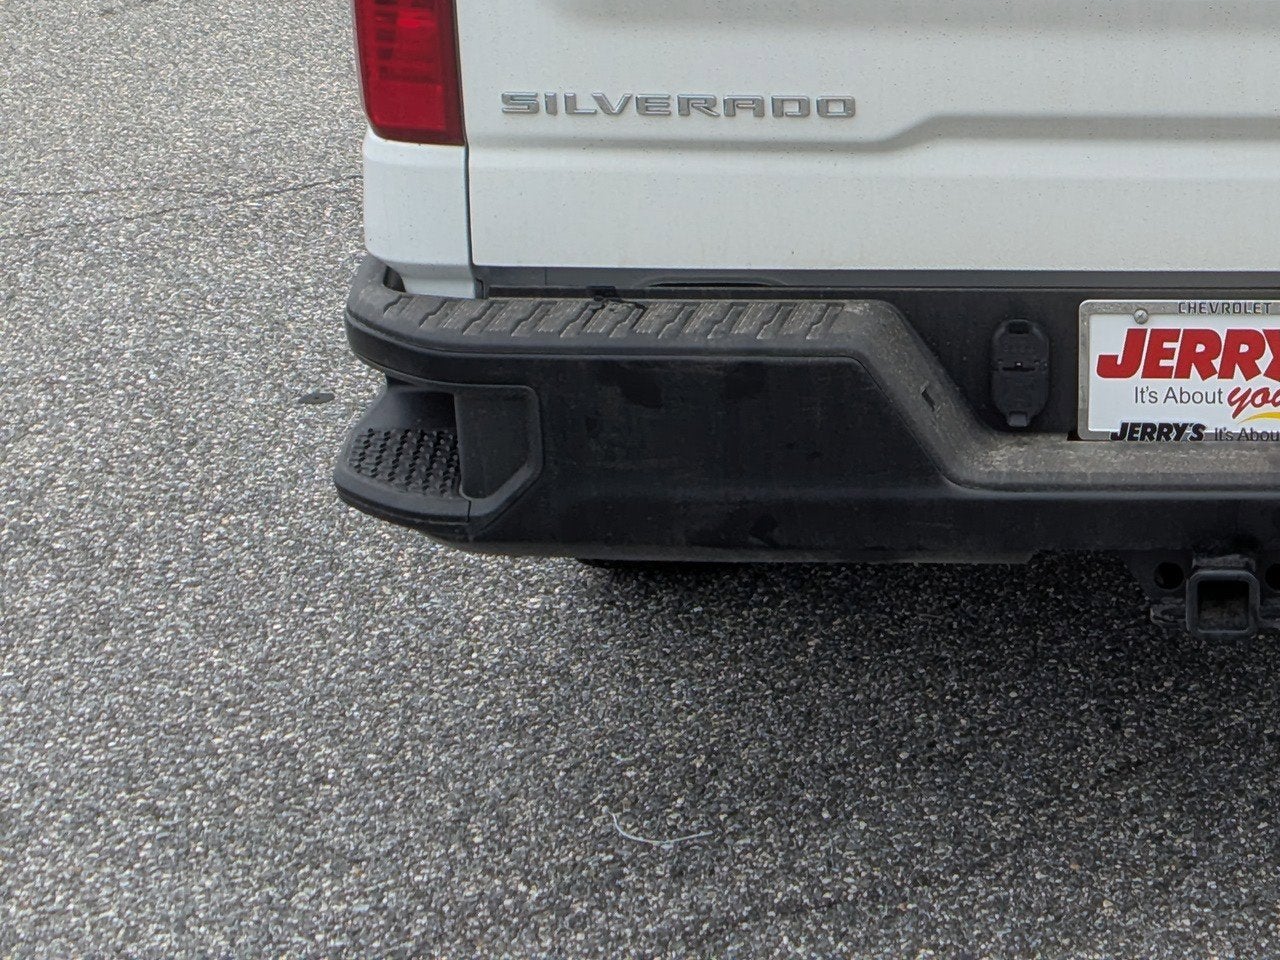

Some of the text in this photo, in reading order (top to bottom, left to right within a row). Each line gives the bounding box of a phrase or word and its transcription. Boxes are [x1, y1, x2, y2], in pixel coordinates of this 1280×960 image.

[500, 91, 856, 118] SILVERADO
[1178, 302, 1272, 315] CHEVROLET
[1134, 385, 1158, 404] It's
[1163, 386, 1223, 404] About
[1110, 422, 1207, 441] JERRY'S
[1214, 426, 1234, 441] It's
